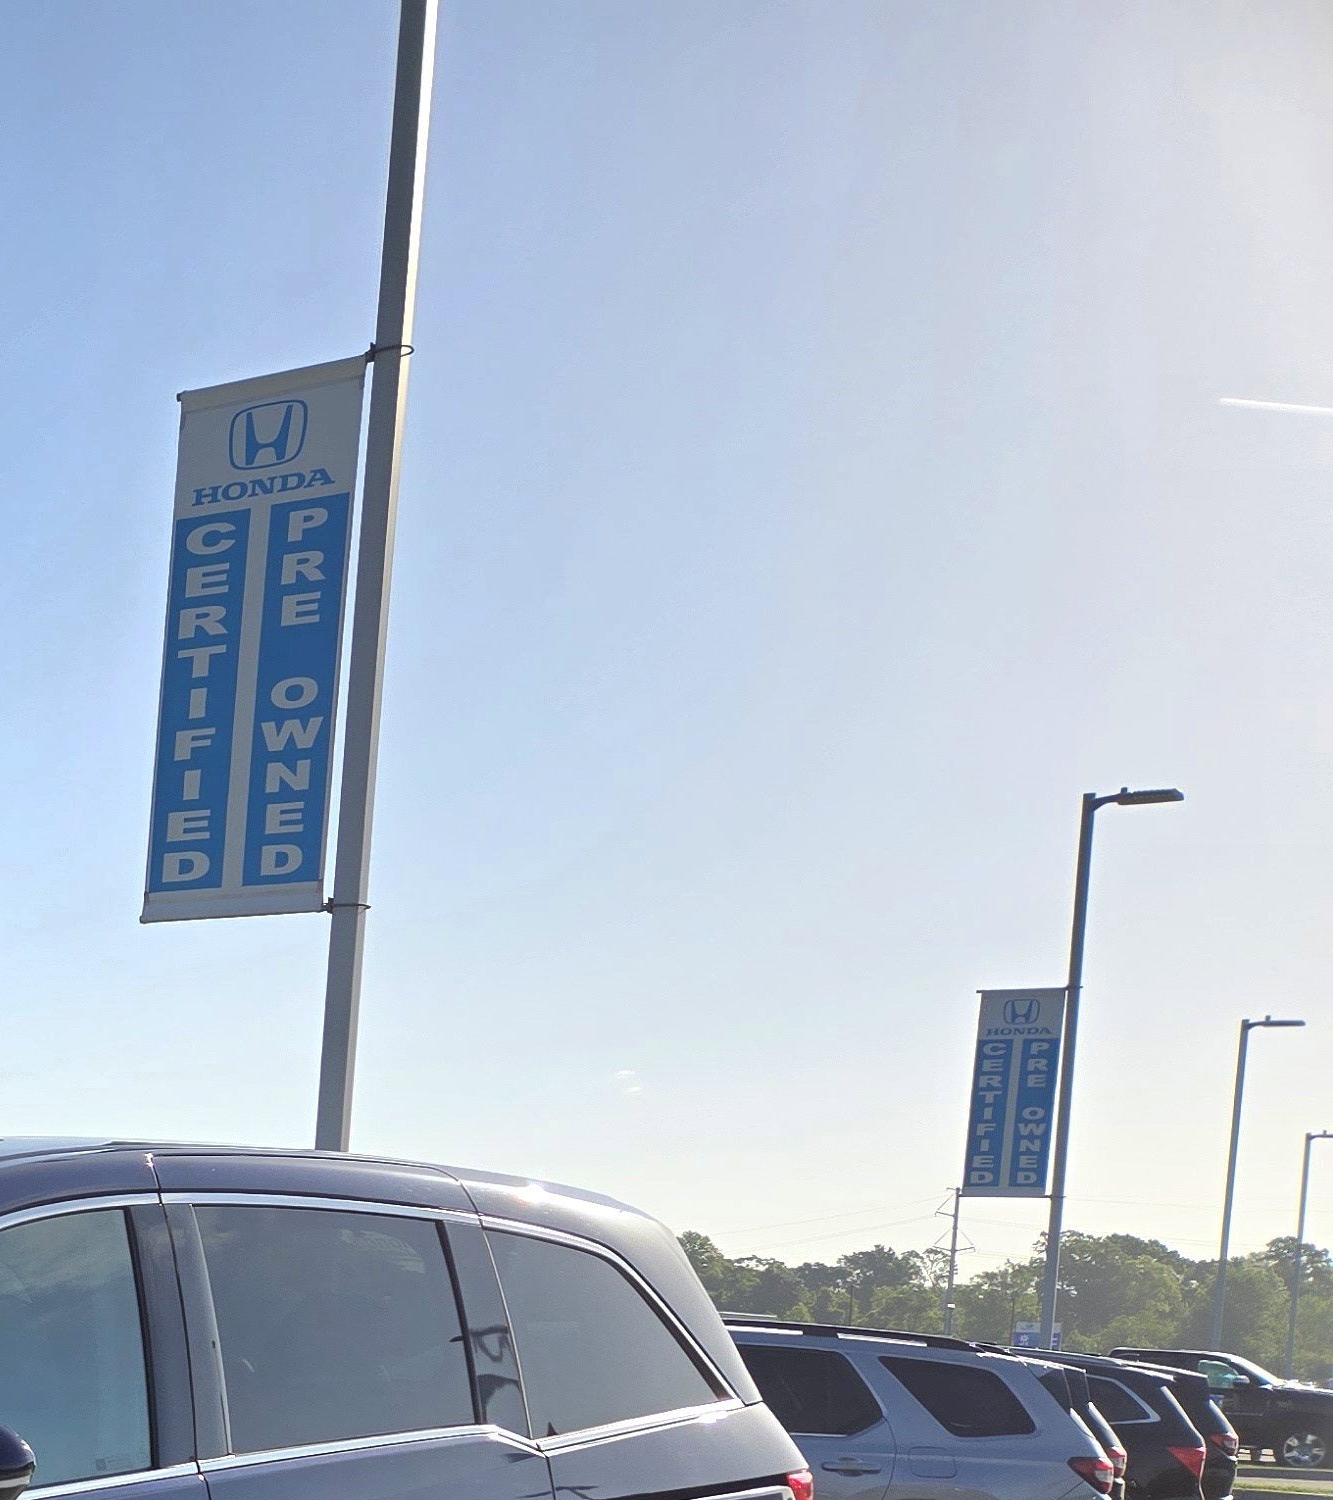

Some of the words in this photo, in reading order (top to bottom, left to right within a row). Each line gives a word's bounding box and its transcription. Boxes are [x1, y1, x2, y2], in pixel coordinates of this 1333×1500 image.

[191, 468, 336, 507] HONDA
[279, 507, 329, 628] PRE
[160, 520, 237, 885] CERTIFIED
[259, 677, 325, 878] OWNED
[985, 1026, 1053, 1037] HONDA
[1026, 1041, 1051, 1088] PRE
[969, 1042, 1007, 1185] CERTIFIED
[1016, 1106, 1047, 1185] OWNED
